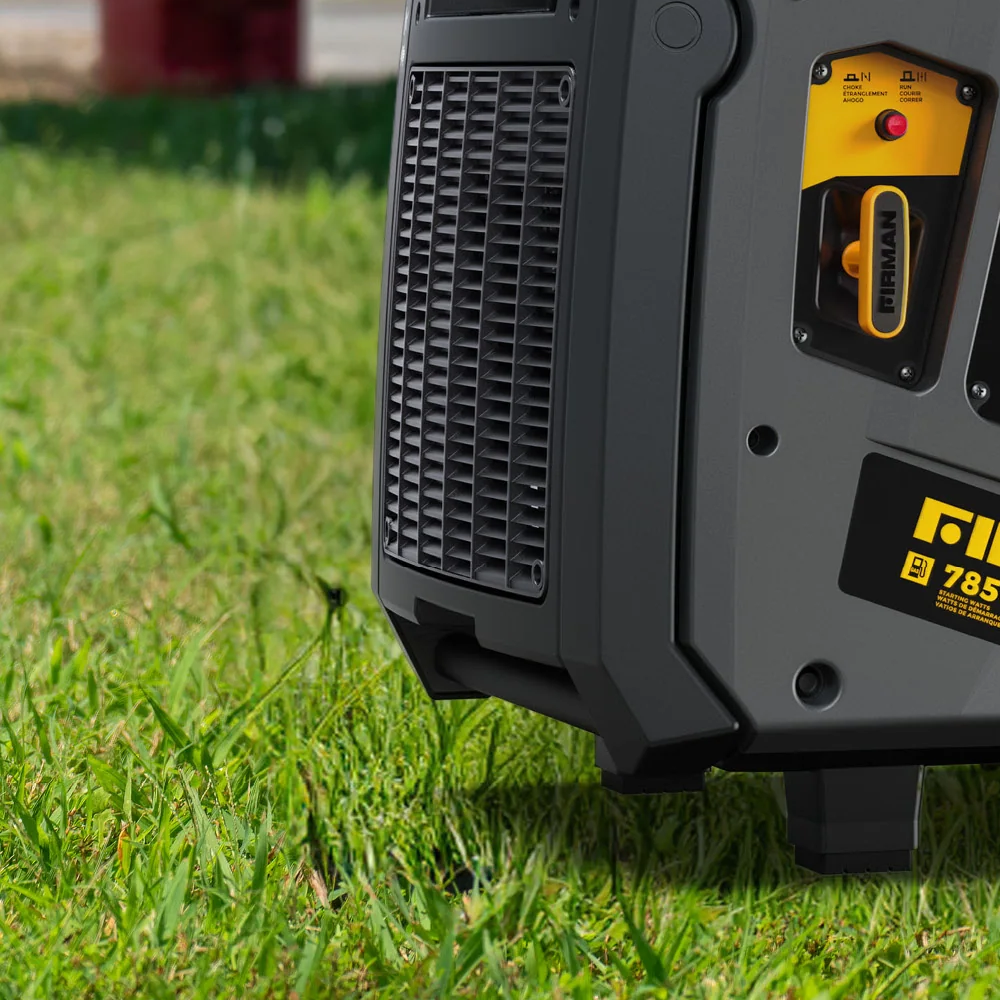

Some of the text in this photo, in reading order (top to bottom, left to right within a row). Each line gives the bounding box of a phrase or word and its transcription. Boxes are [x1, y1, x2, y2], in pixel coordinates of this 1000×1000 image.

[879, 210, 896, 314] FIRMAN
[936, 602, 957, 613] VATIOS
[937, 595, 958, 606] WATTS
[939, 590, 990, 611] STARTING WATTS
